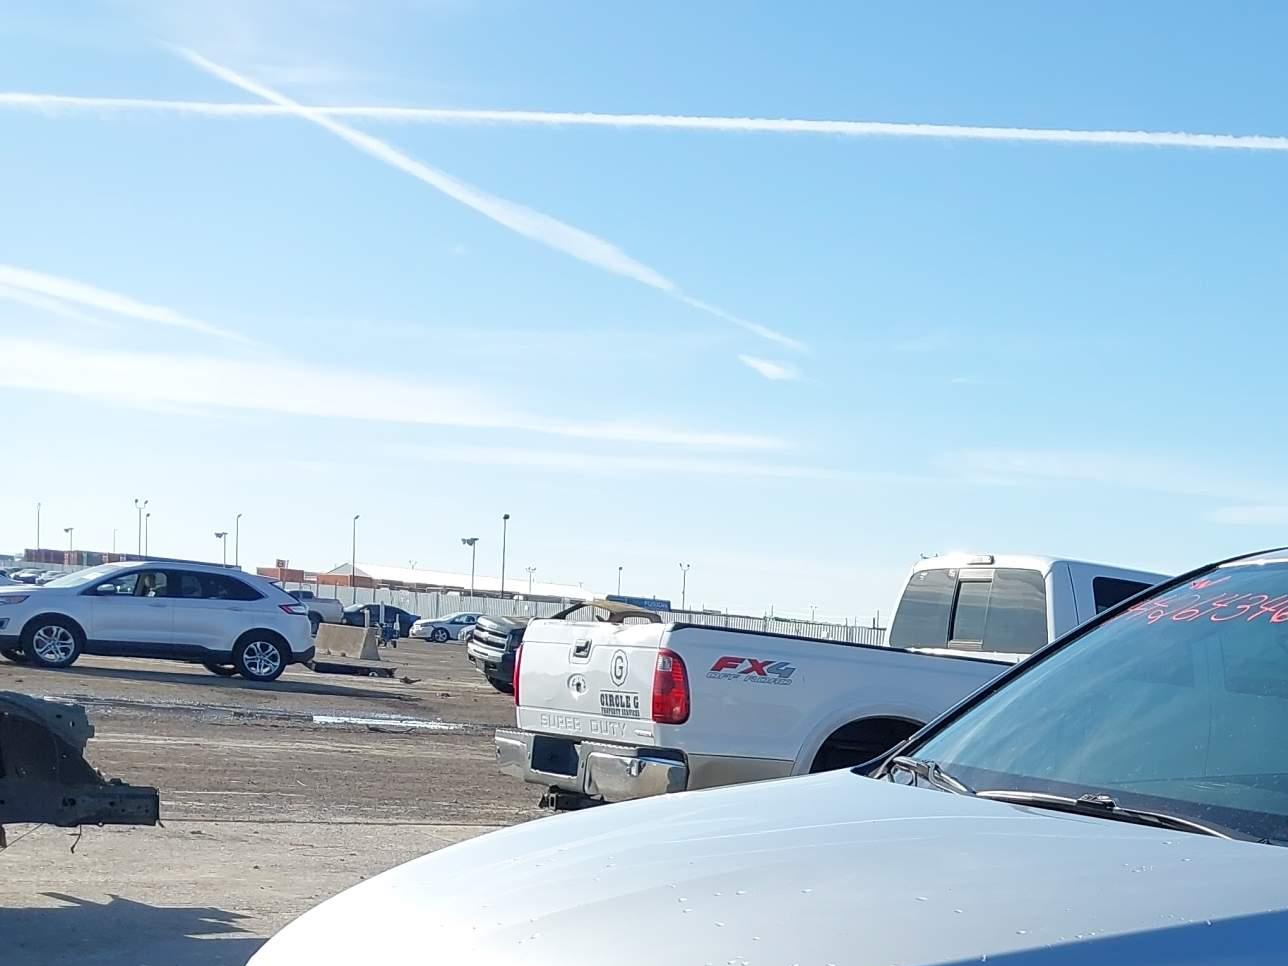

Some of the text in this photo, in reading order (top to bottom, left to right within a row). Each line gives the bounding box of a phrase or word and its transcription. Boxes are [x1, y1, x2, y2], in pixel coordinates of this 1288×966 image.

[709, 655, 797, 679] FX4
[705, 671, 793, 686] OFF ROAD
[600, 693, 640, 710] CIRCLE G
[540, 713, 627, 737] SUPER DUTY
